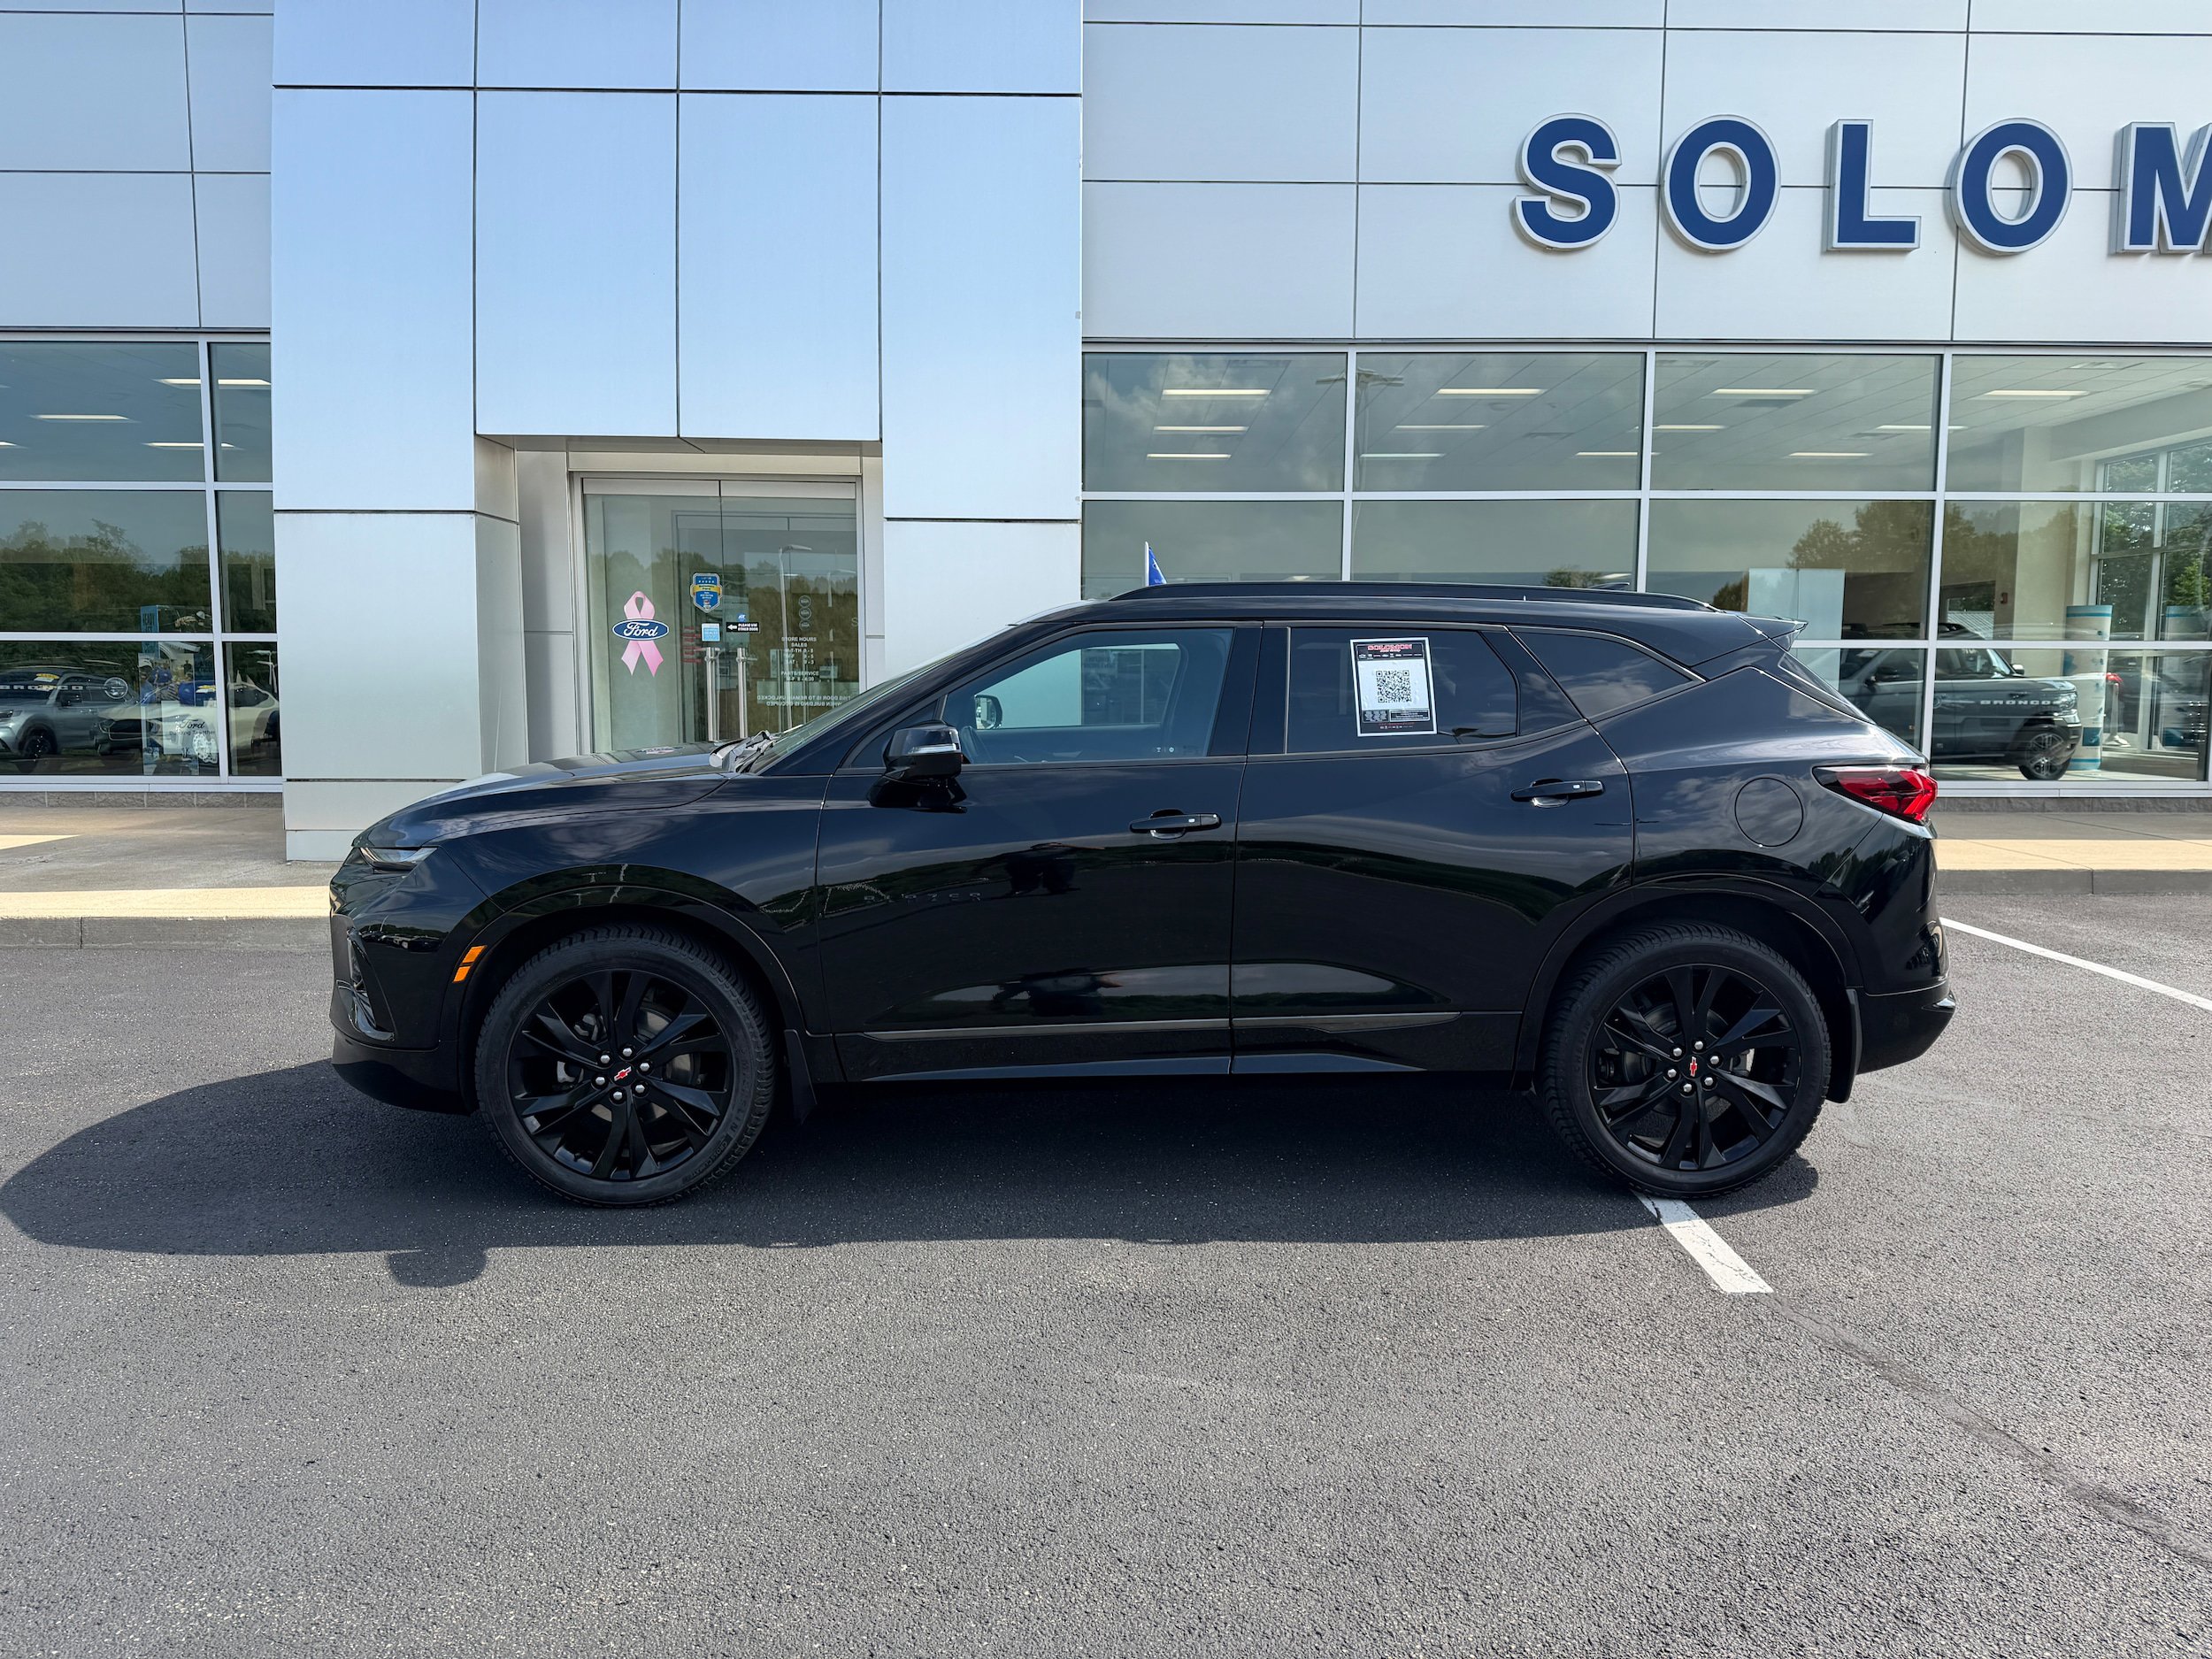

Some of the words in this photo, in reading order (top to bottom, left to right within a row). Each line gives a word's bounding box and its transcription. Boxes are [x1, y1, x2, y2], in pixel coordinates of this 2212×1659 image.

[1514, 112, 2212, 255] SOLOM
[623, 622, 658, 636] Ford
[180, 718, 205, 729] Ford
[864, 893, 981, 904] BLAZER
